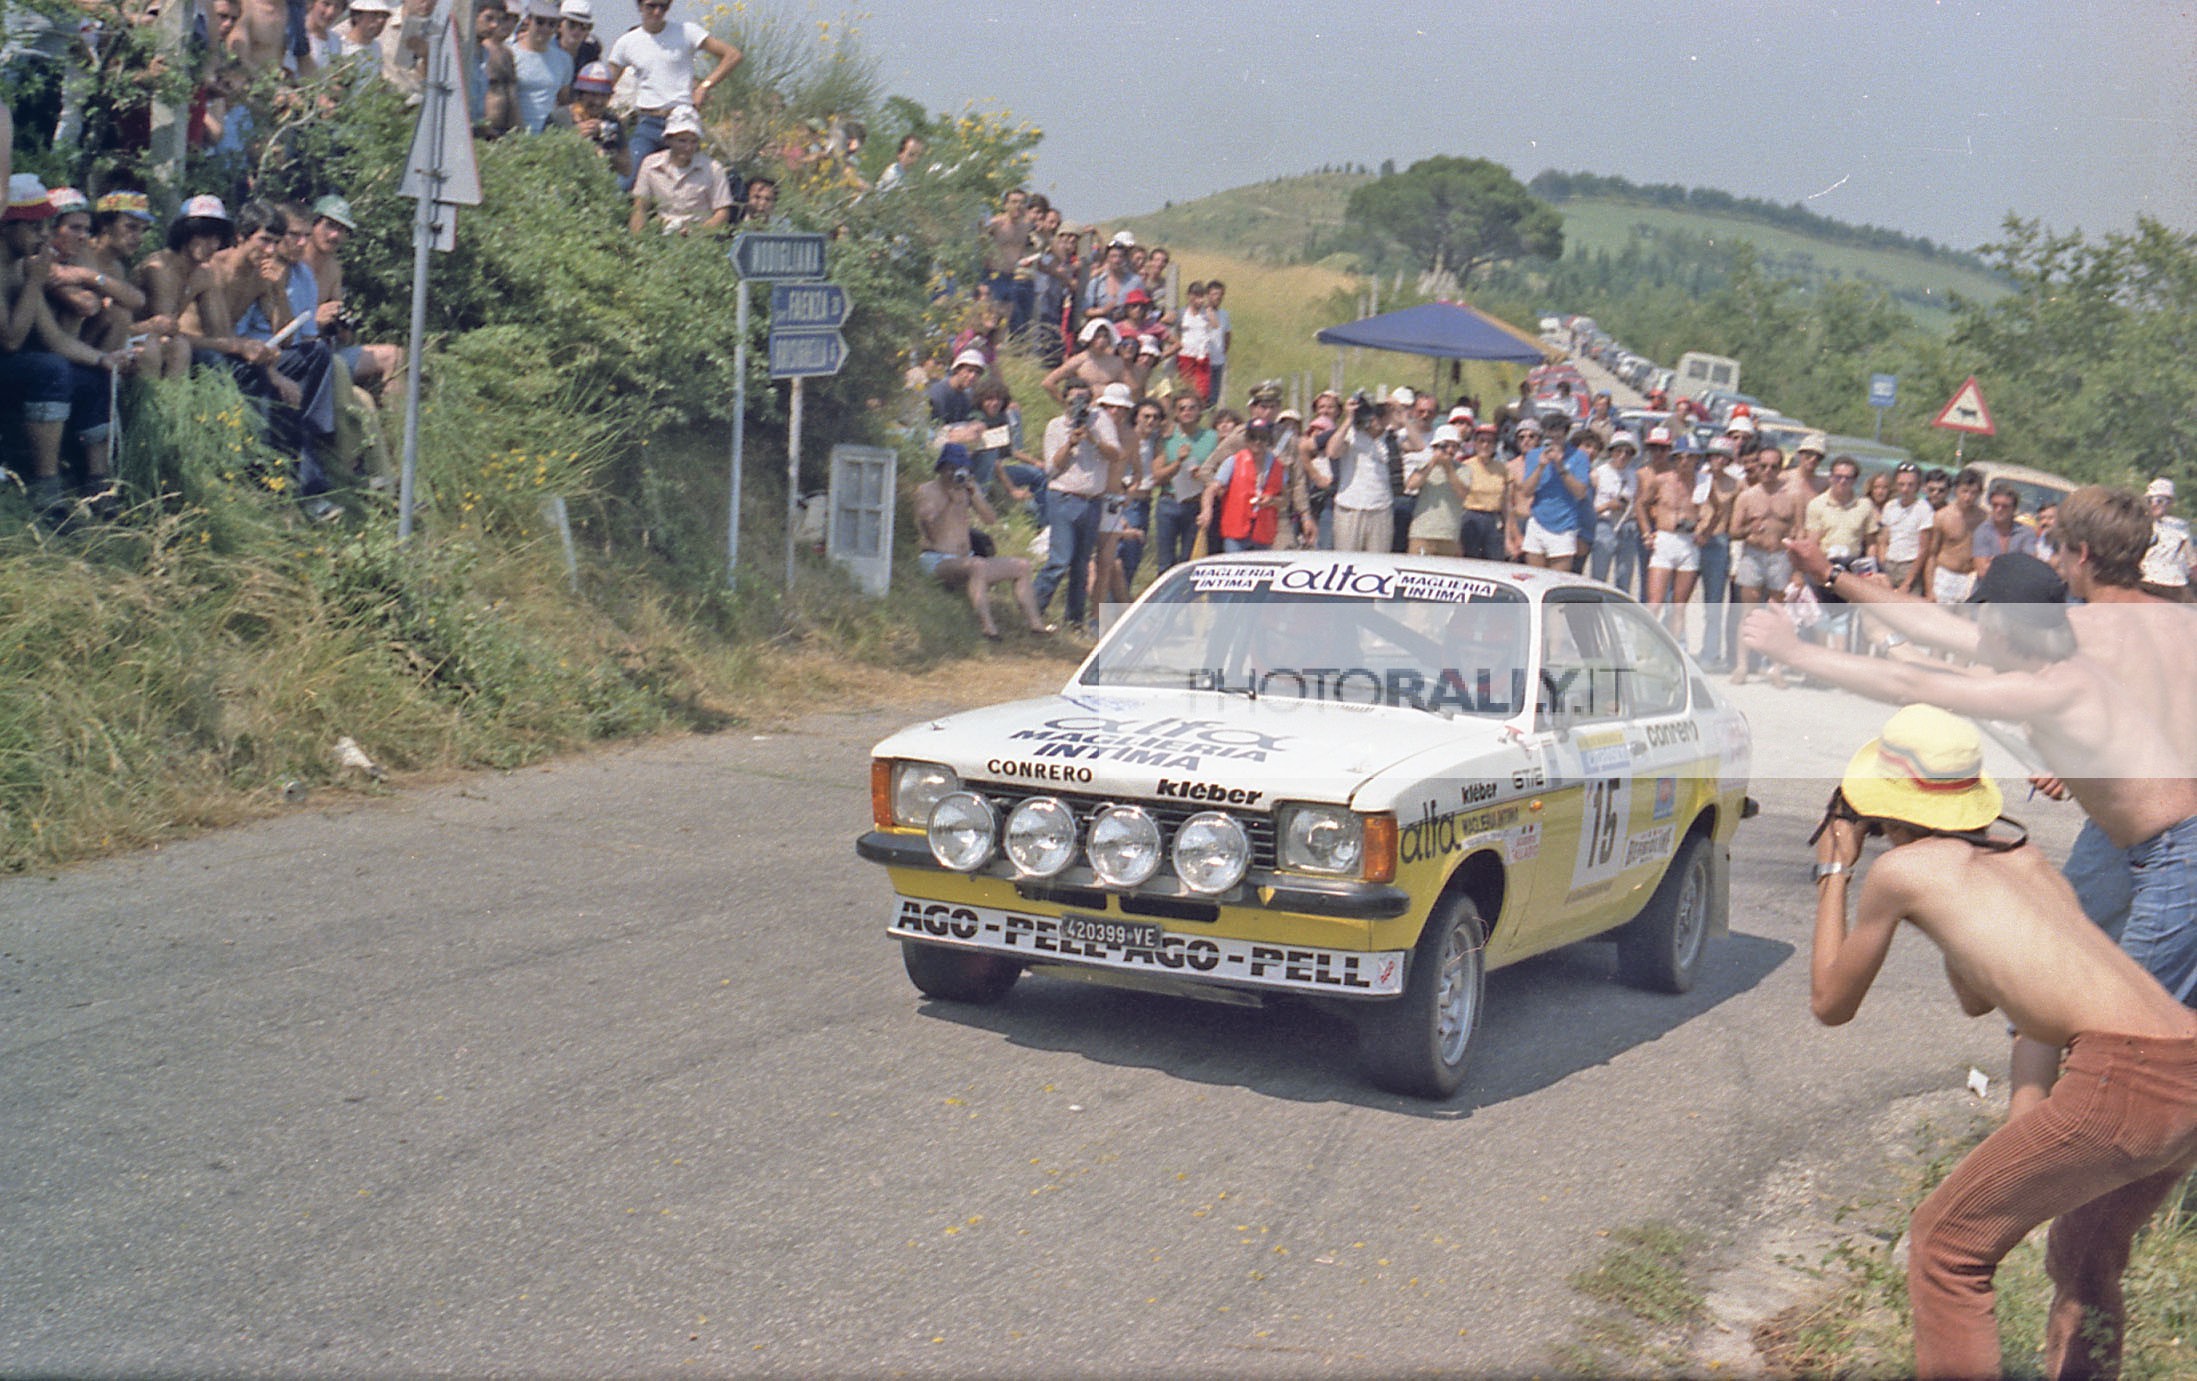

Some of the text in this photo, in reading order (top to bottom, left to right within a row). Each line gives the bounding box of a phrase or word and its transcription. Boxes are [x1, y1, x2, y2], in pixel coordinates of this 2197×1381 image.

[1194, 568, 1275, 577] MAGLIERIA
[1200, 579, 1253, 588] INTIMA
[1401, 575, 1491, 594] MAGLIERIA
[1408, 587, 1466, 603] INTIMA
[1008, 730, 1267, 762] MAGLIERIA
[1033, 743, 1200, 771] INTIMA
[987, 759, 1093, 783] CONRERO
[1157, 779, 1263, 805] kléber
[1587, 778, 1620, 868] 15
[1067, 919, 1155, 947] 420399 VE
